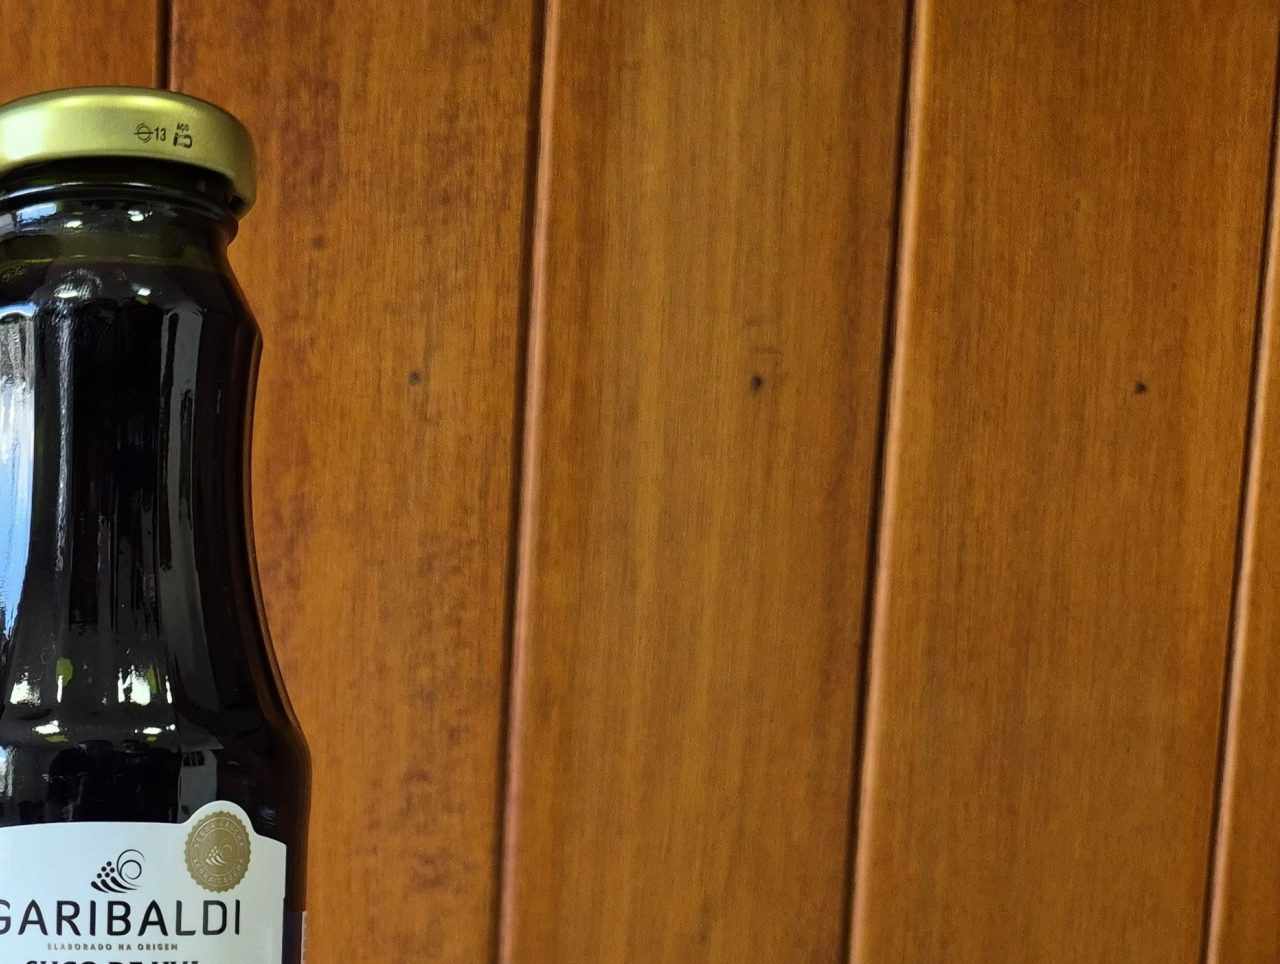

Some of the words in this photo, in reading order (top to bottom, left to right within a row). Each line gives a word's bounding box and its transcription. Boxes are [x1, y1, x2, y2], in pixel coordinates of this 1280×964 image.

[154, 127, 167, 142] 13
[47, 943, 112, 951] ELABORADO
[119, 943, 132, 951] NA
[137, 943, 178, 951] ORIGEM
